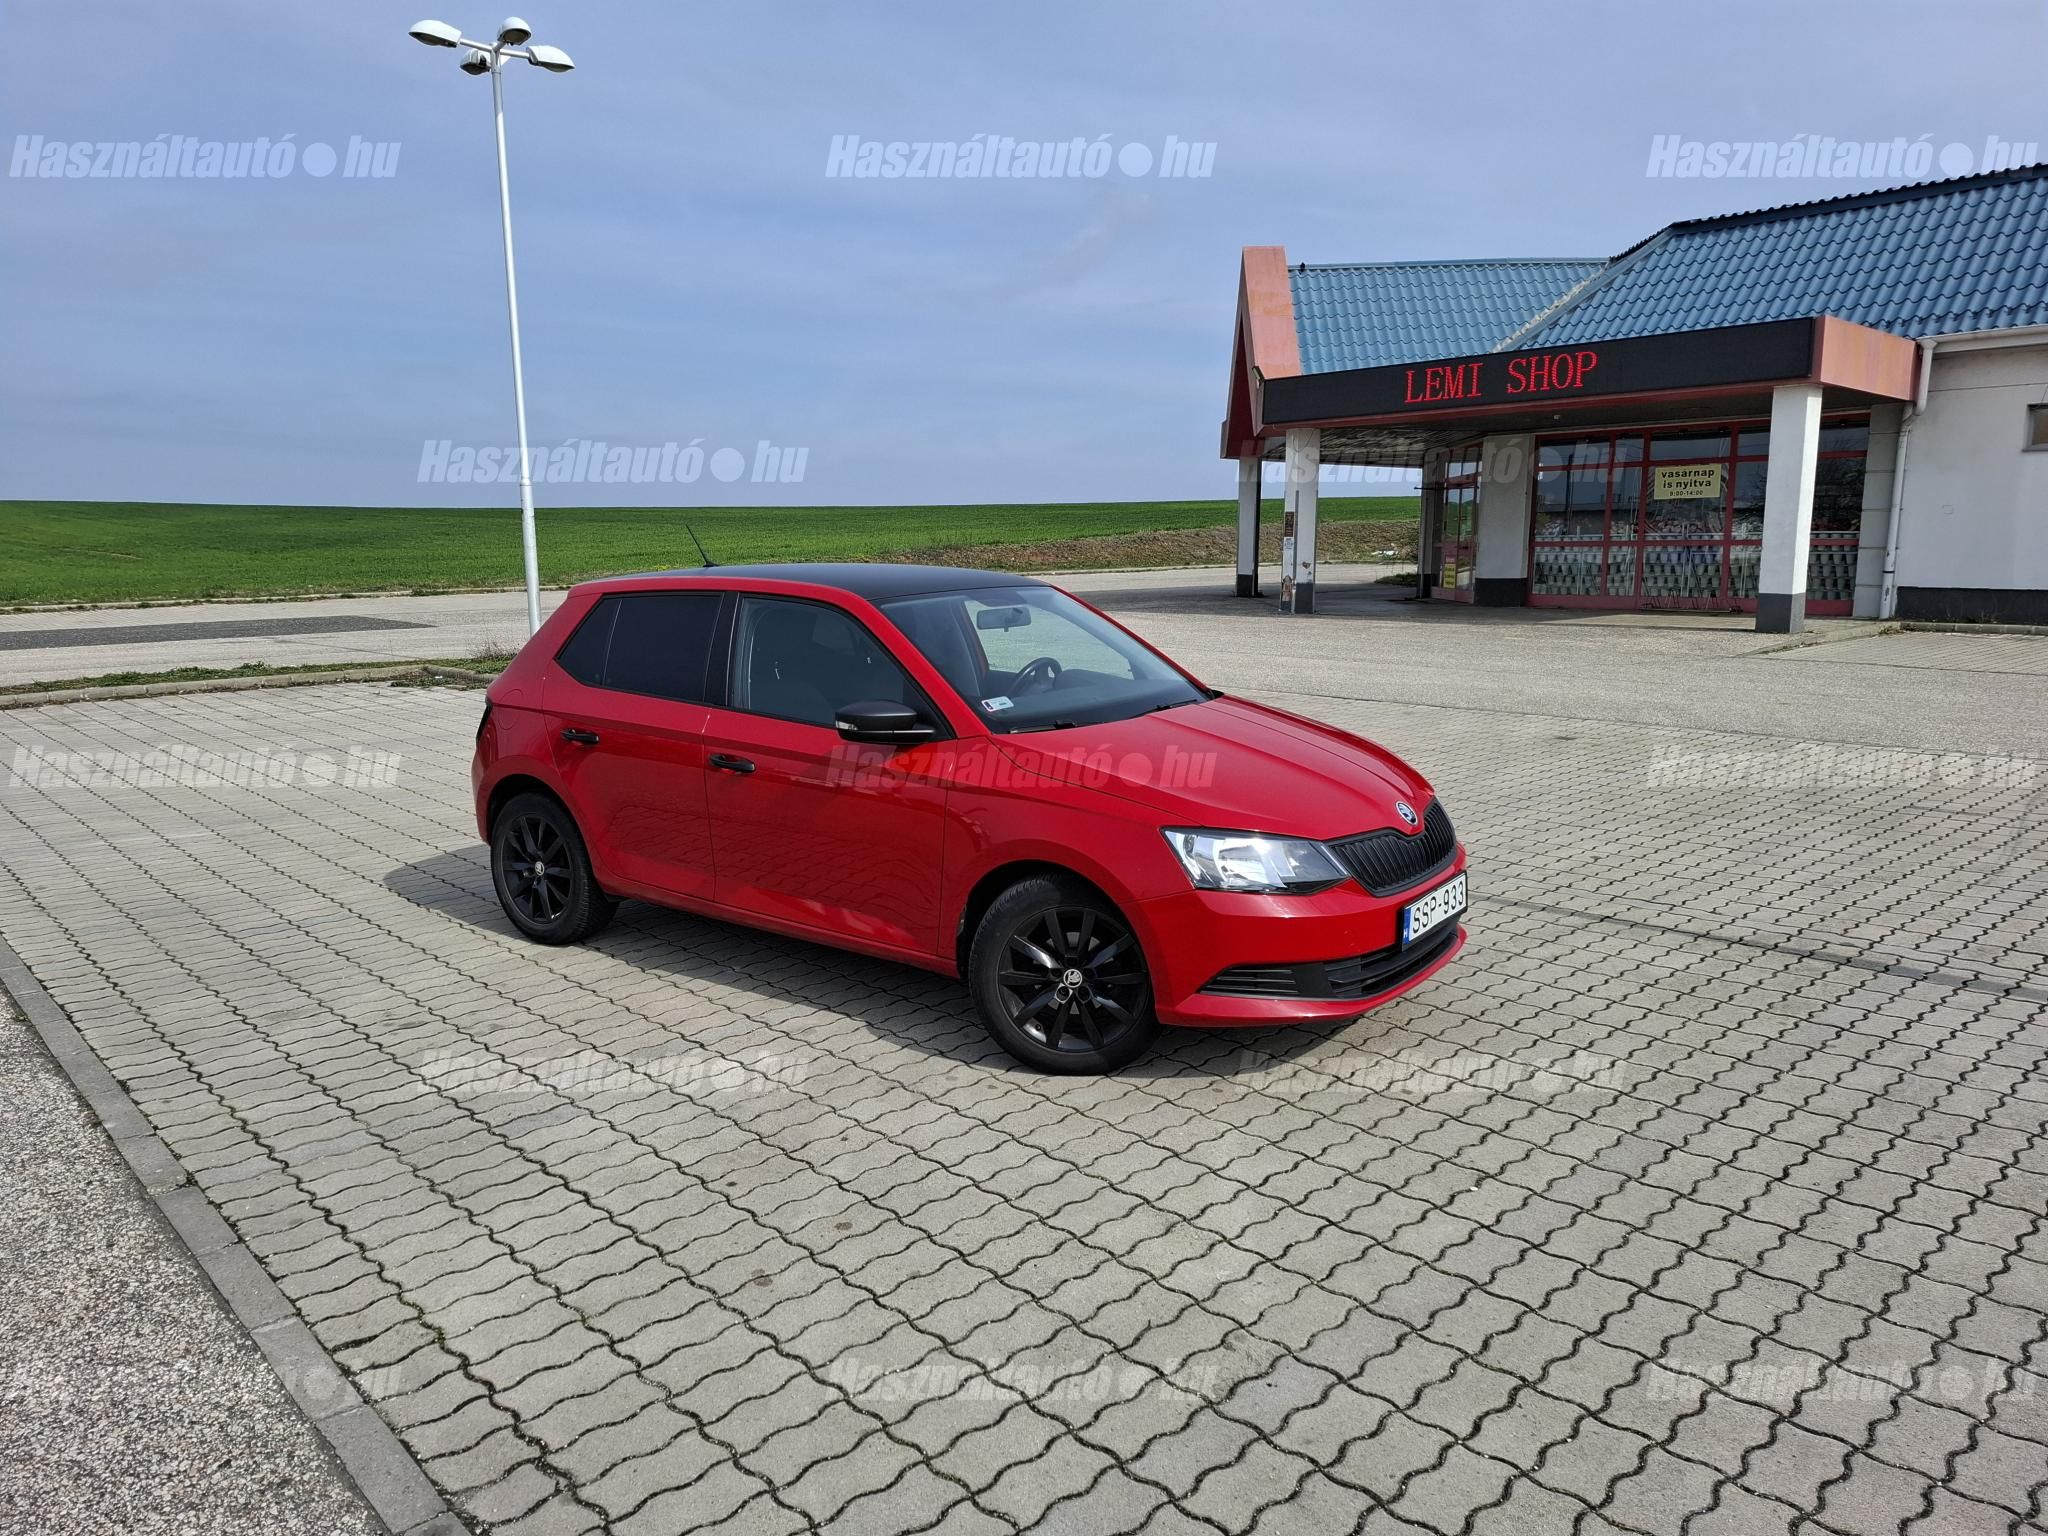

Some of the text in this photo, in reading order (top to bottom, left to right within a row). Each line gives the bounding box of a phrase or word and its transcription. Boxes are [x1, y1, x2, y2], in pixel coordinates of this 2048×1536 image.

[1404, 351, 1599, 404] LEMI SHOP
[1663, 479, 1712, 490] is nyitva
[1412, 881, 1464, 934] SSP-933
